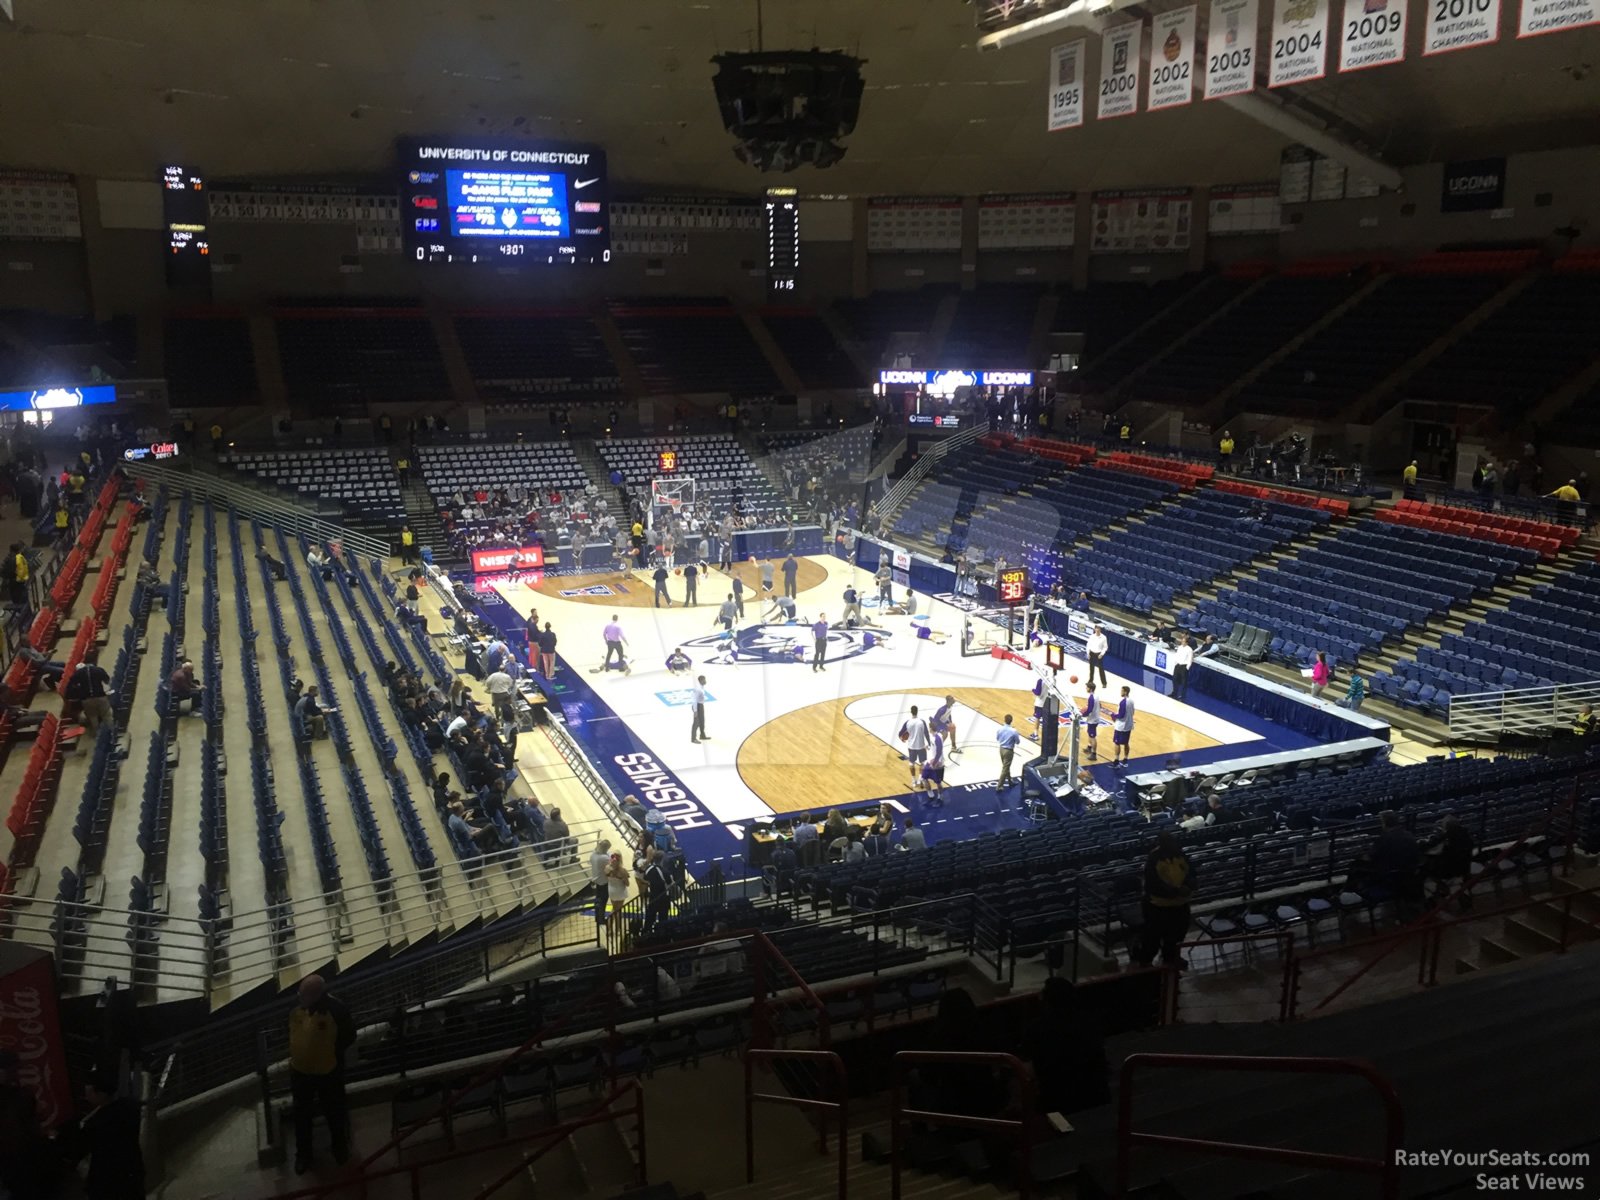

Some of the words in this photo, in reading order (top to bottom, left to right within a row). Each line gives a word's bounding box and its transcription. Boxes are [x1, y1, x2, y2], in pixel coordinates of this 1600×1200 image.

[1435, 0, 1490, 22] 2010
[1533, 0, 1590, 16] NATIONAL
[1347, 11, 1401, 41] 2009
[1437, 18, 1486, 35] NATIONAL
[1528, 9, 1594, 31] CHAMPIONS
[1275, 30, 1322, 59] 2004
[1351, 38, 1394, 53] NATIONAL
[1431, 30, 1490, 49] CHAMPIONS
[1210, 48, 1251, 73] 2003
[1278, 56, 1315, 69] NATIONAL
[1346, 50, 1397, 67] CHAMPIONS
[1152, 61, 1189, 85] 2002
[1213, 71, 1246, 84] NATIONAL
[1275, 66, 1318, 83] CHAMPIONS
[1101, 74, 1136, 96] 2000
[1155, 84, 1184, 95] NATIONAL
[1209, 82, 1249, 96] CHAMPIONS
[1053, 89, 1079, 109] 1995
[1104, 95, 1130, 105] NATIONAL
[1152, 93, 1187, 106] CHAMPIONS
[419, 146, 491, 160] UNIVERSITY
[492, 150, 508, 161] OF
[510, 151, 590, 165] CONNECTICUT
[1449, 175, 1498, 191] UCONN
[416, 247, 424, 260] 0
[603, 249, 611, 262] 0
[881, 371, 927, 384] UCONN
[983, 372, 1031, 385] UCONN
[151, 442, 174, 454] Coke
[663, 459, 674, 469] 30
[1002, 572, 1024, 583] 43:07
[1004, 583, 1021, 599] 30
[614, 752, 712, 831] HUSKIES
